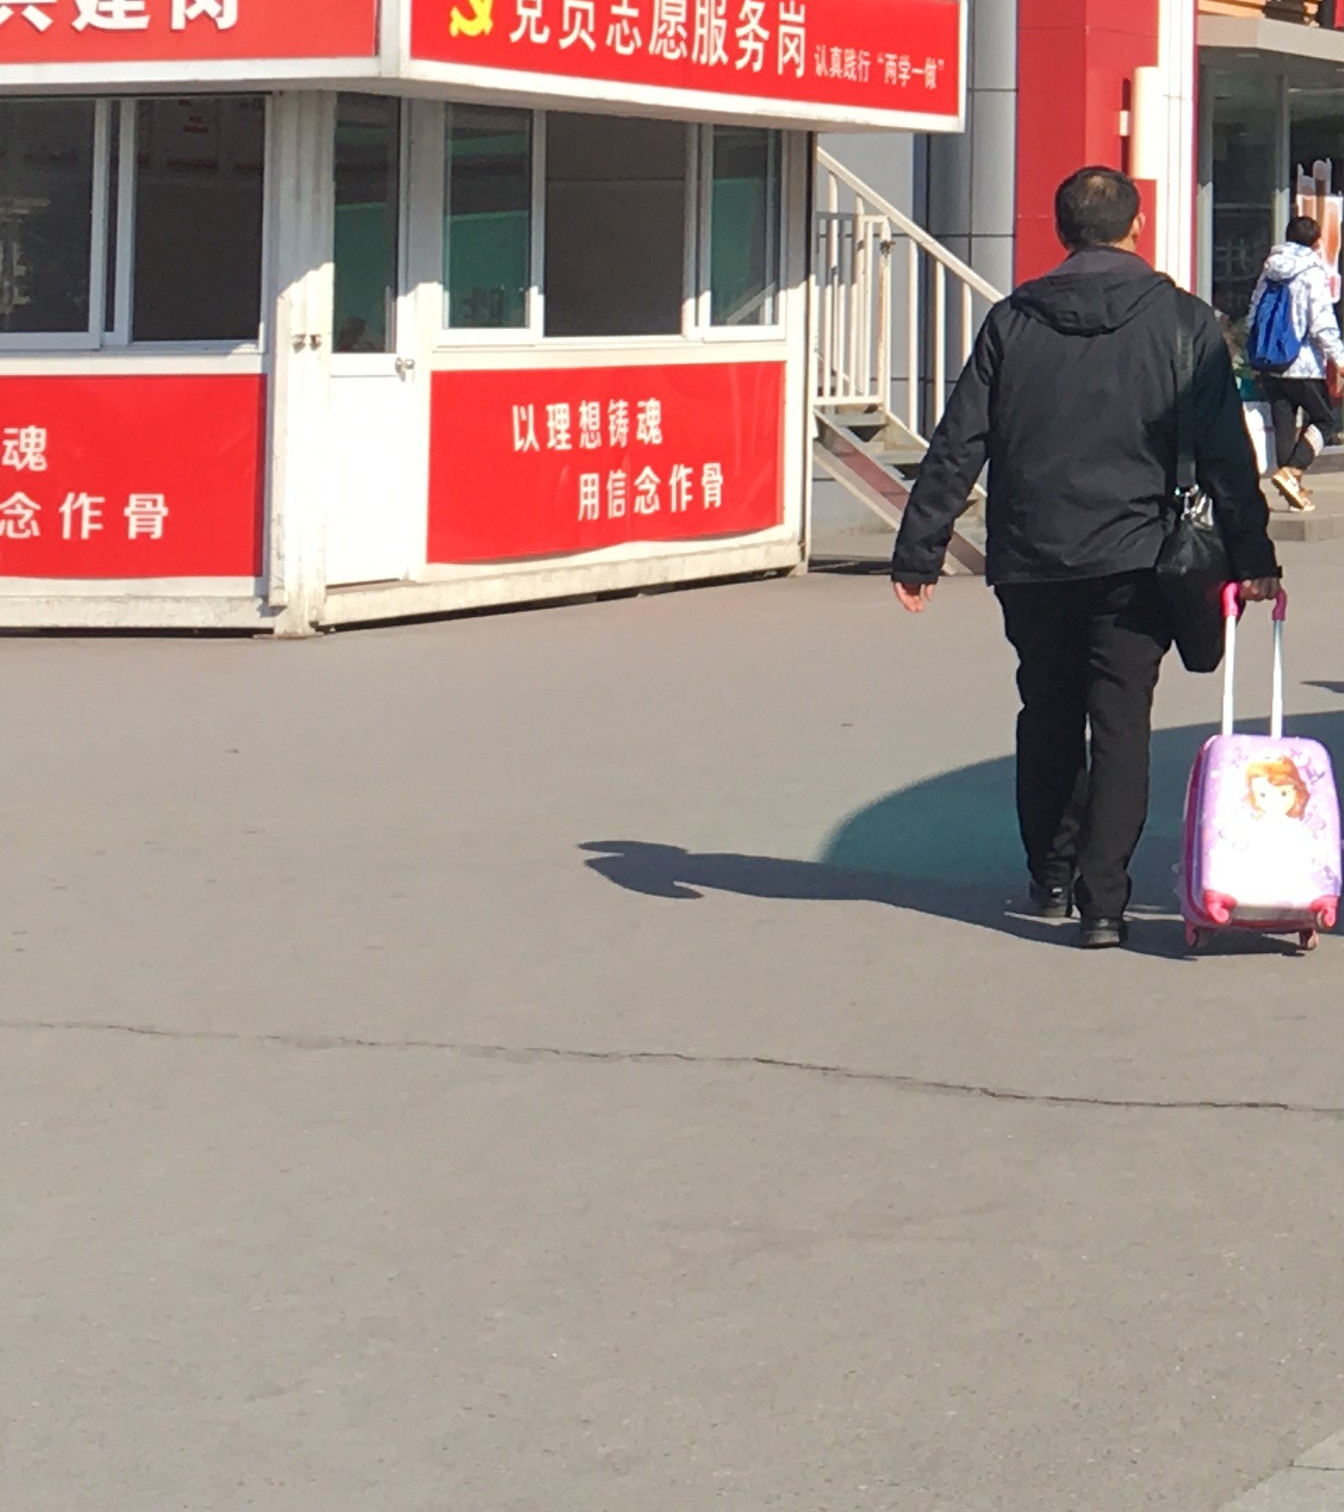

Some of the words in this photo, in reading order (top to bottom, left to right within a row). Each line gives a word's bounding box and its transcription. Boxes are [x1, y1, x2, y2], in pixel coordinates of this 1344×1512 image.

[1, 424, 48, 472] 魂
[511, 397, 664, 454] 以理想铸魂
[0, 491, 169, 541] 念作骨
[577, 462, 726, 523] 用信念作骨
